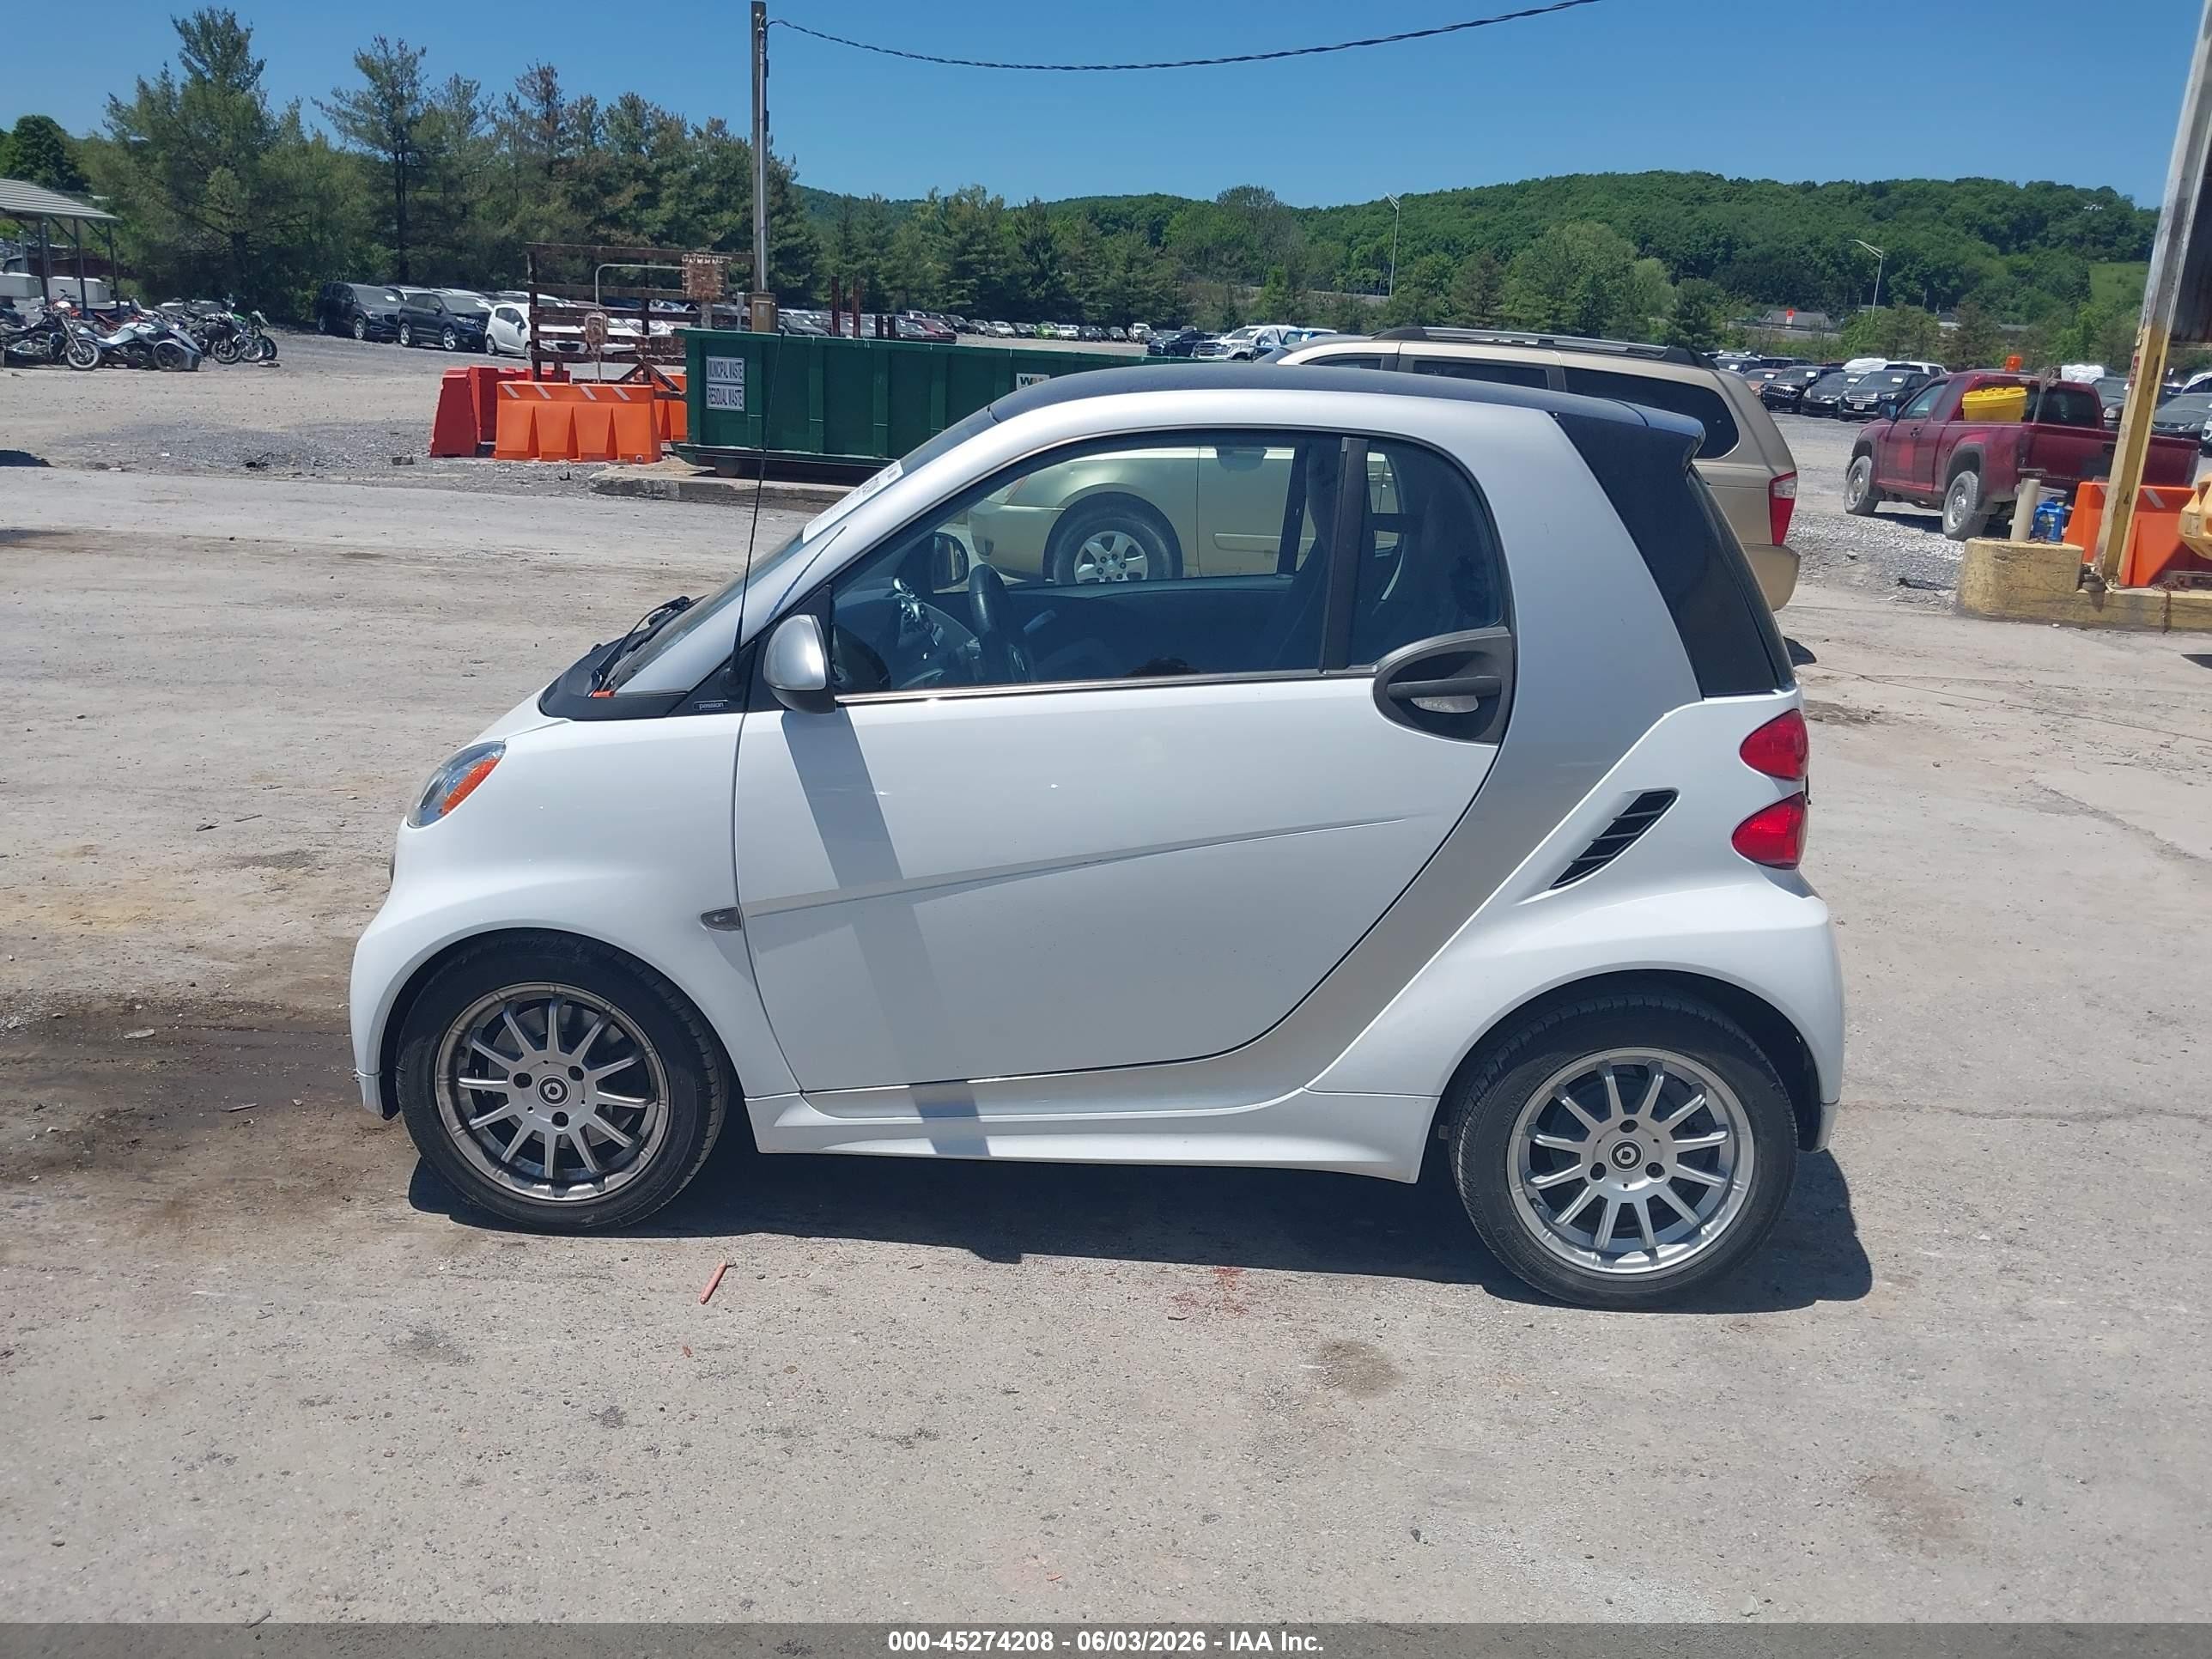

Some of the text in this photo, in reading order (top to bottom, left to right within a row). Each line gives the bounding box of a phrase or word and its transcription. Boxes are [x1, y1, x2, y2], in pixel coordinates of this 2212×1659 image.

[729, 362, 742, 380] WASTE
[708, 387, 742, 407] RESIDUAL WASTE
